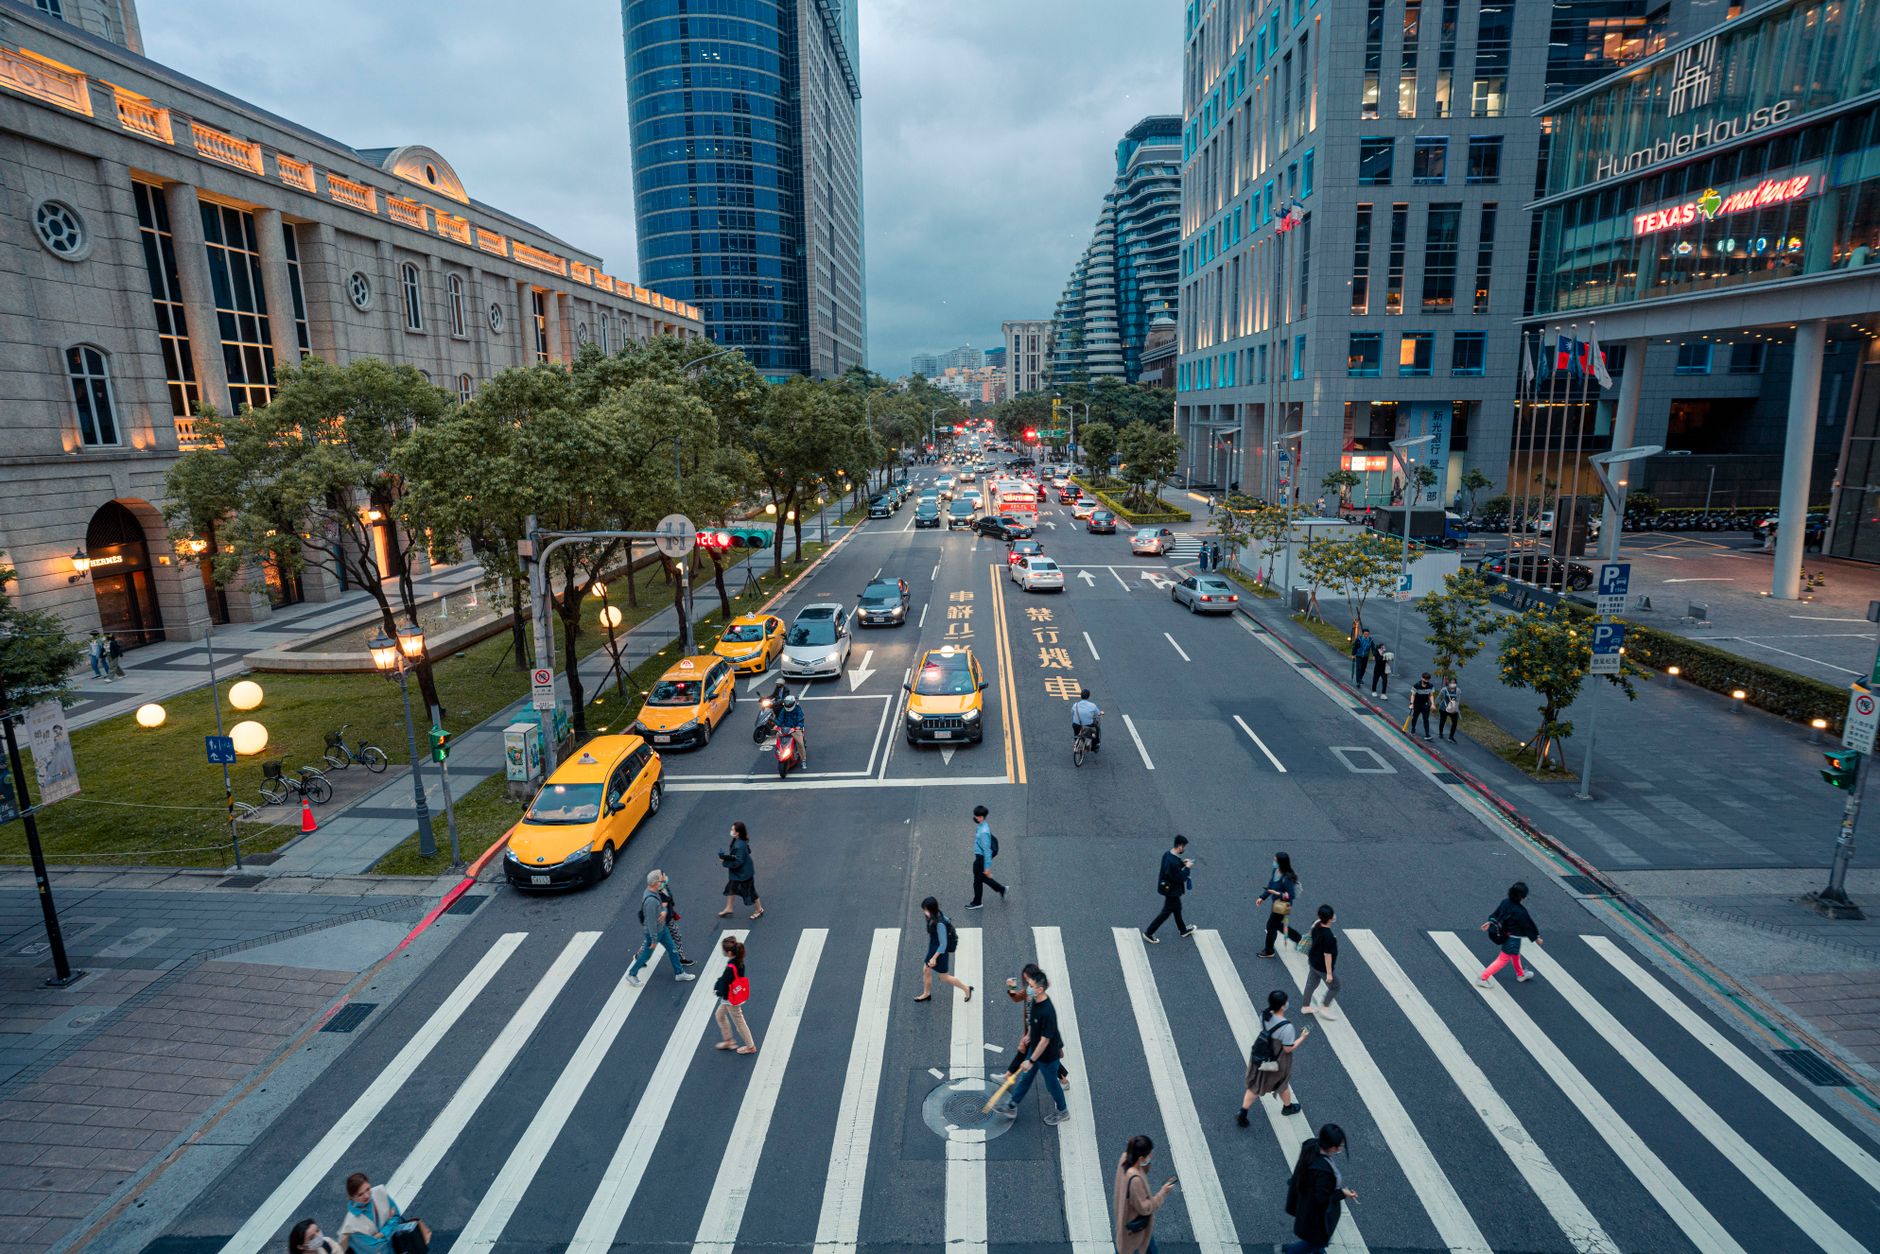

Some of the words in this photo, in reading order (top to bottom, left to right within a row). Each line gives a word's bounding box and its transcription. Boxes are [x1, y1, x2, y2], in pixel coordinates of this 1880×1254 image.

[1596, 100, 1792, 181] HumbleHouse
[1634, 202, 1696, 236] TEXAS
[1426, 410, 1444, 502] 新光銀行營部
[1398, 576, 1407, 590] P
[1604, 567, 1620, 585] P
[1596, 626, 1613, 644] P
[1025, 608, 1081, 700] 禁行機車
